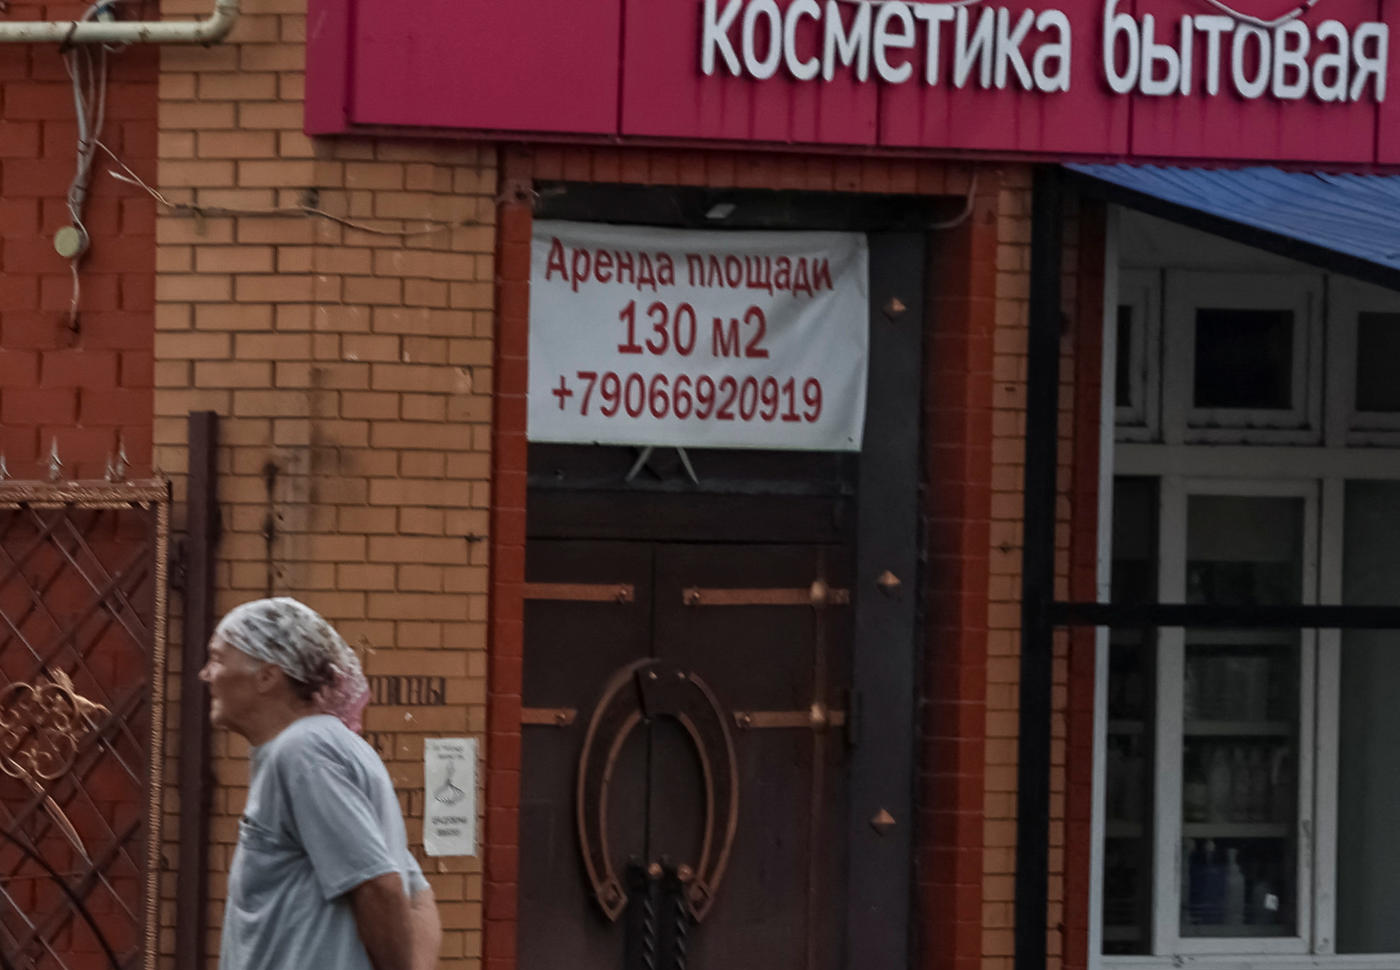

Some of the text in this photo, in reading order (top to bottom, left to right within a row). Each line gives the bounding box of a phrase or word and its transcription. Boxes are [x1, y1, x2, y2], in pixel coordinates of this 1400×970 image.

[702, 0, 1389, 103] косметика бытовая
[546, 236, 834, 298] Аренда площади
[617, 299, 769, 359] 130 м2
[552, 370, 823, 423] +79066920919
